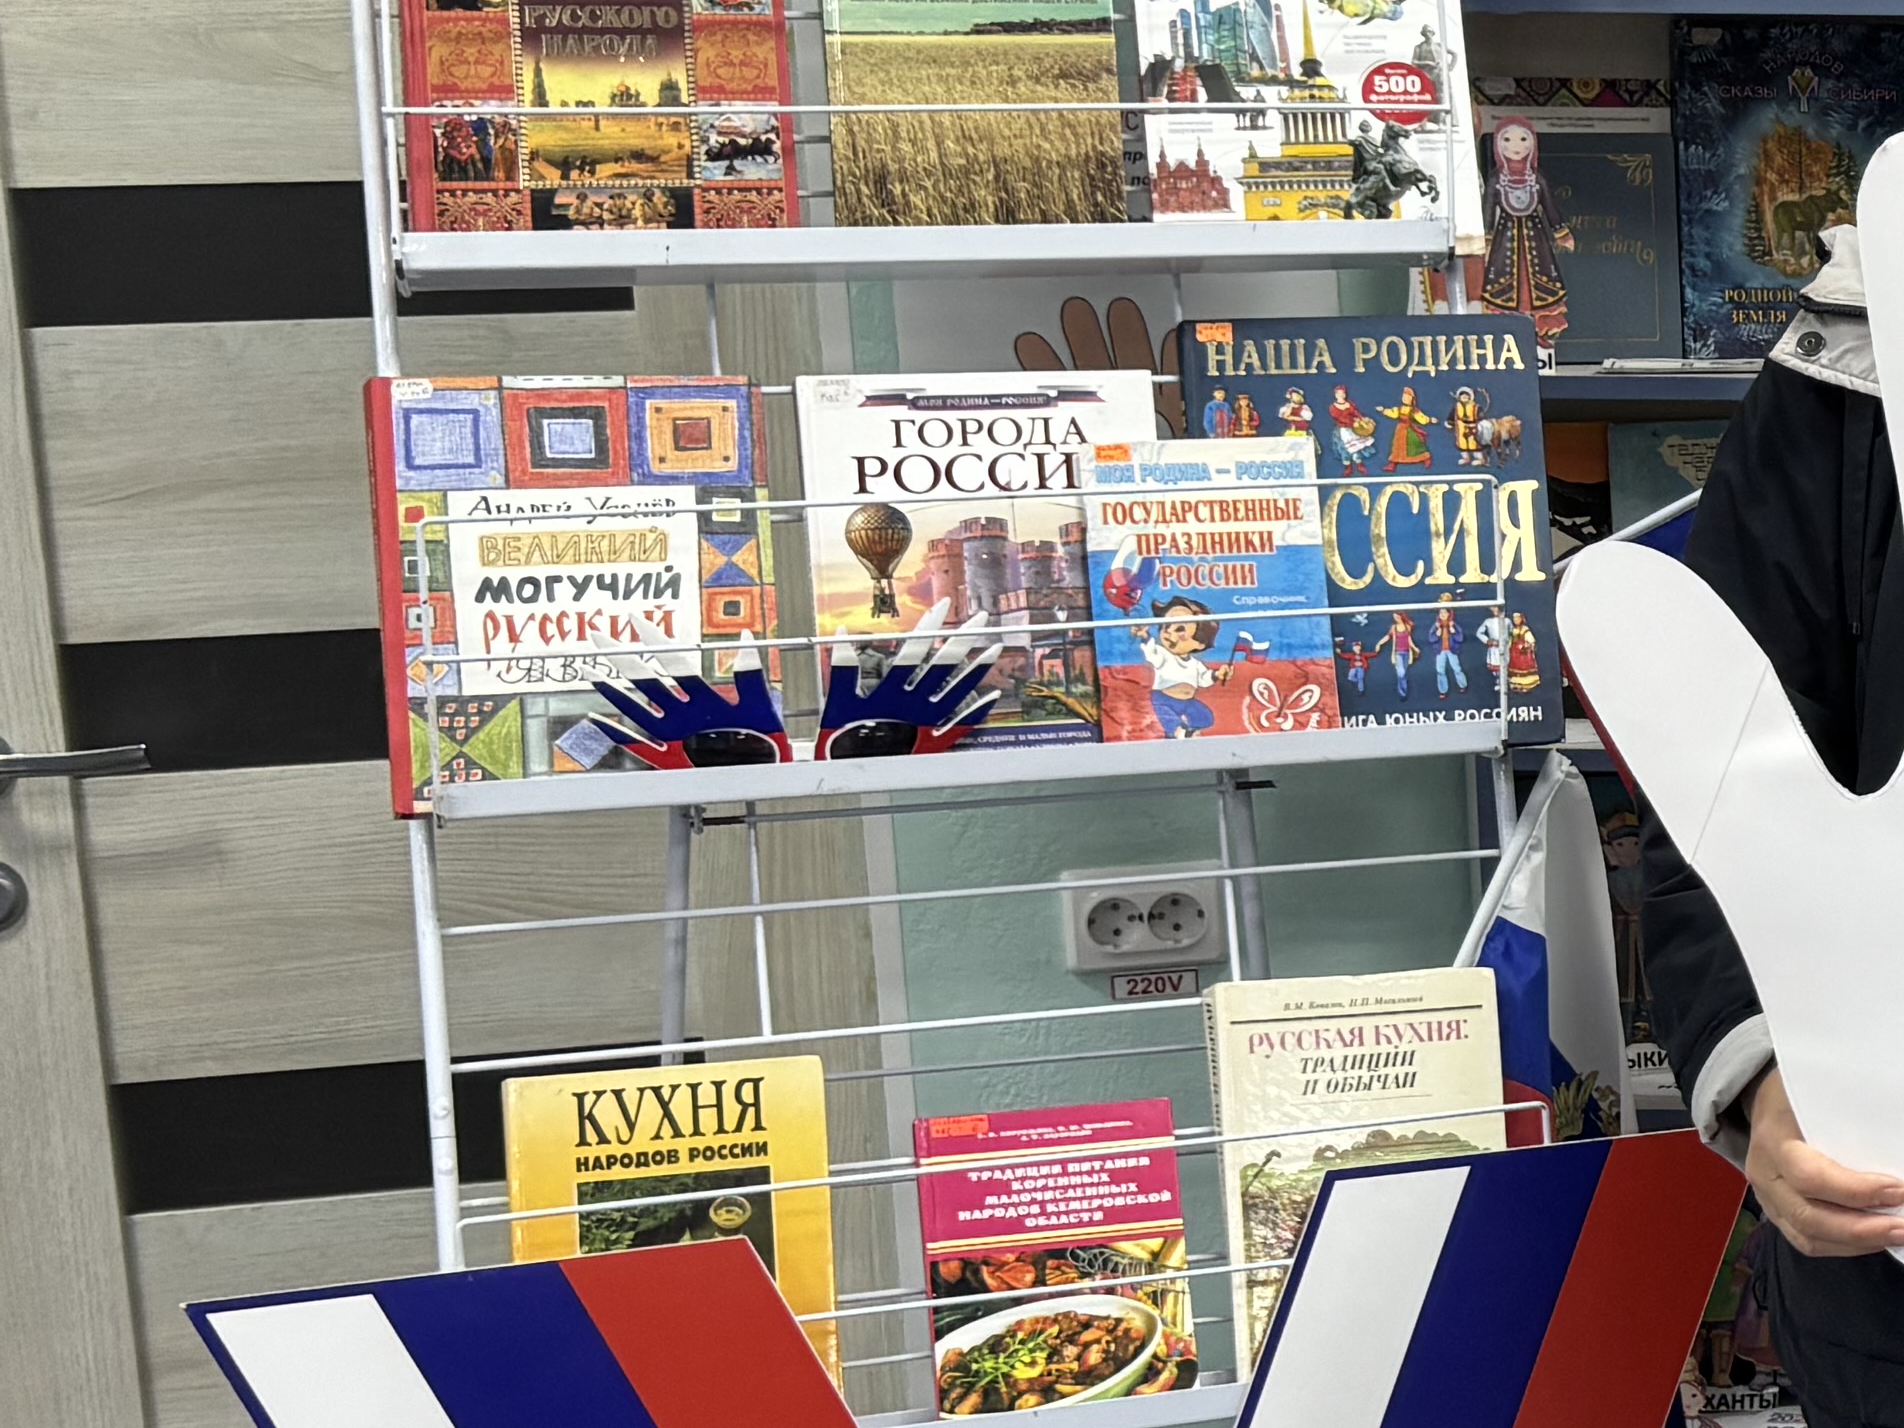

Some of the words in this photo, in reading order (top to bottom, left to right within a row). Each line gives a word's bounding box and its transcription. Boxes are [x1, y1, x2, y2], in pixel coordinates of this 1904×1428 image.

[524, 5, 678, 29] РУССКОГО
[541, 34, 658, 57] НАРОДА
[1374, 76, 1421, 92] 500
[1719, 87, 1776, 98] СКАЗЫ
[1731, 310, 1787, 323] ЗЕМЛЯ
[1206, 339, 1336, 376] НАША
[1354, 335, 1525, 378] РОДИНА
[890, 417, 1088, 452] ГОРОДА
[852, 452, 1081, 494] РОССИ
[1095, 464, 1135, 483] МОЯ
[1140, 463, 1211, 485] РОДИНА
[1235, 461, 1305, 479] РОССИЯ
[1102, 498, 1304, 527] ГОСУДАРСТВЕННЫЕ
[481, 527, 667, 565] ВЕЛИКИЙ
[1136, 531, 1276, 556] ПРАЗДНИКИ
[475, 565, 681, 603] МОГУЧИЙ
[1160, 564, 1257, 588] РОССИИ
[1127, 975, 1183, 996] 220V
[1248, 1026, 1365, 1058] РУССКАЯ
[1374, 1019, 1469, 1053] КУХНЯ:
[1300, 1050, 1415, 1075] ТРАДИЦИИ
[1302, 1079, 1318, 1096] И
[1326, 1072, 1417, 1095] ОБЫЧАИ
[572, 1076, 767, 1147] КУХНЯ
[576, 1150, 680, 1172] НАРОДОВ
[688, 1141, 768, 1163] РОССИИ
[967, 1164, 1062, 1182] ТРАДИЦИИ
[1068, 1156, 1150, 1173] ПИТАНИЯ
[1011, 1173, 1110, 1190] КОРЕННЫХ
[958, 1204, 1041, 1221] НАРОДОВ
[1046, 1190, 1172, 1213] КЕМЕРОВСКОЙ
[985, 1183, 1138, 1205] МАЛОЧИСЛЕННЫХ
[1025, 1211, 1103, 1227] ОБЛАСТИ
[1702, 1392, 1776, 1410] ХАНТЫ
